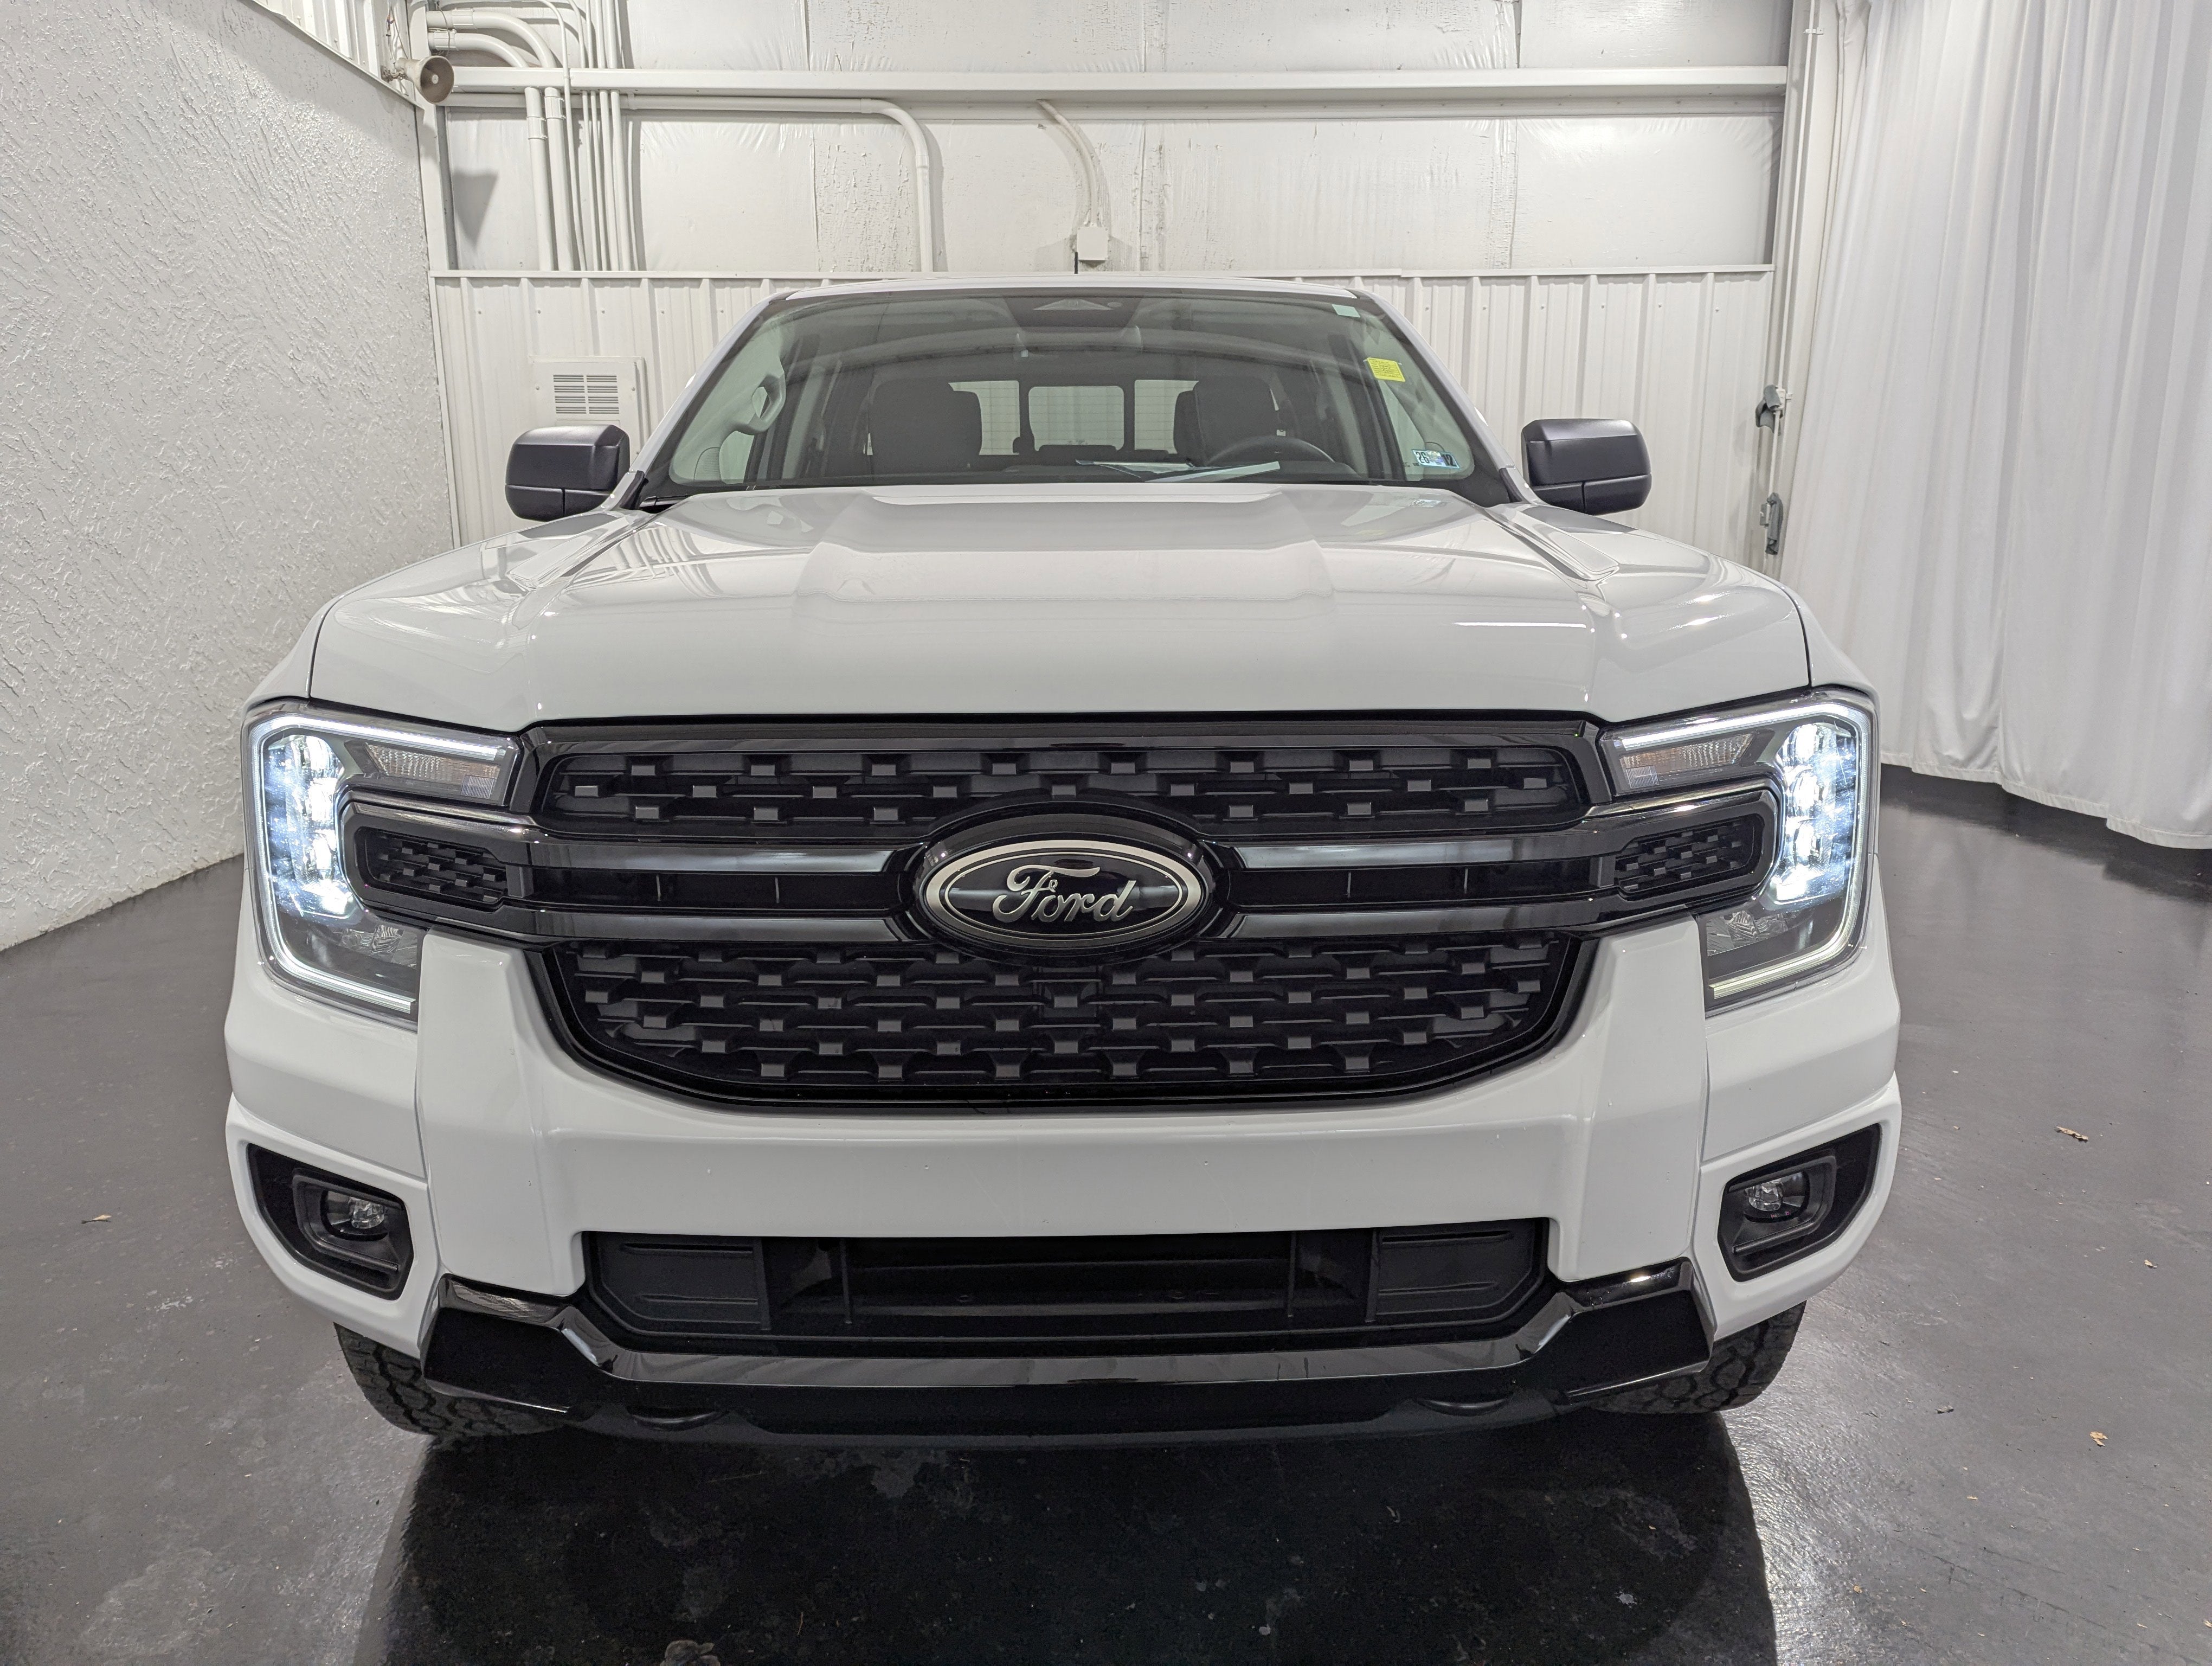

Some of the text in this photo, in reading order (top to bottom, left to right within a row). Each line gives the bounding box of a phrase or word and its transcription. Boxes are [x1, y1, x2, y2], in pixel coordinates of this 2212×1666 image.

[1415, 451, 1457, 466] 26 12
[992, 864, 1135, 922] Ford
